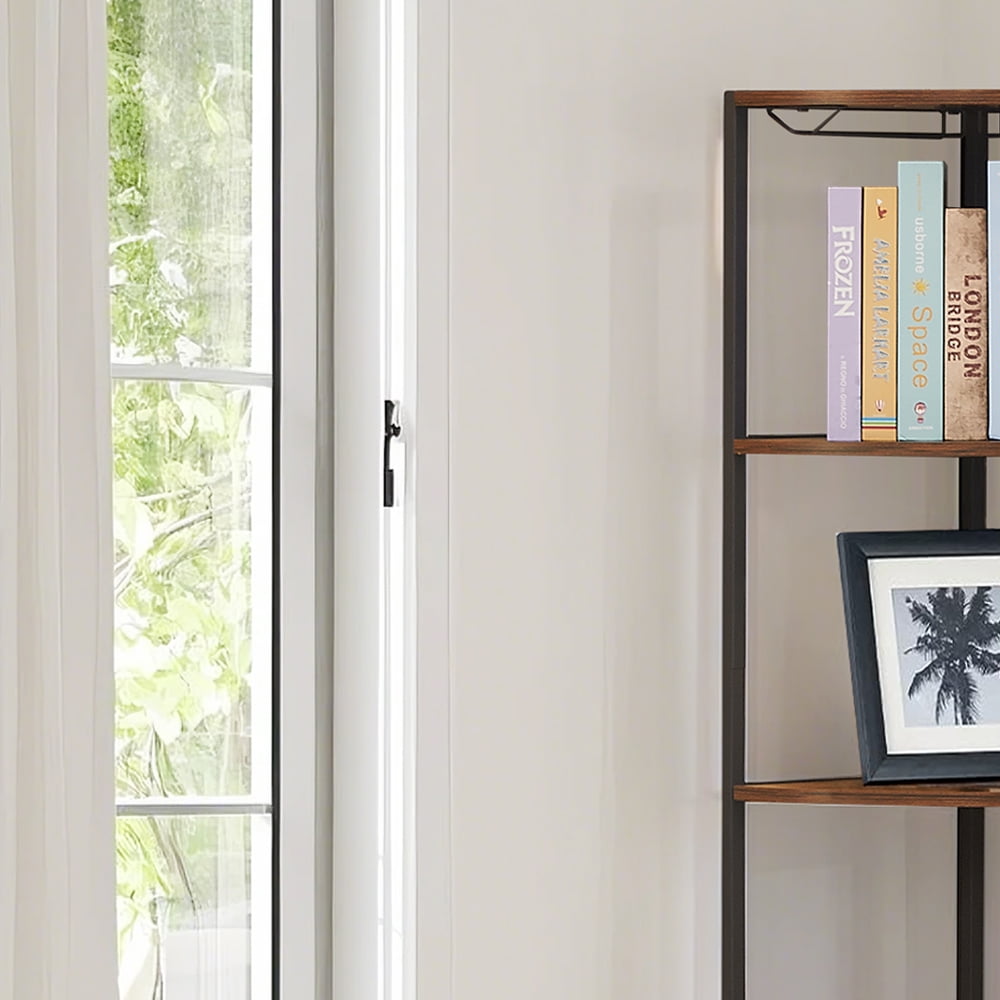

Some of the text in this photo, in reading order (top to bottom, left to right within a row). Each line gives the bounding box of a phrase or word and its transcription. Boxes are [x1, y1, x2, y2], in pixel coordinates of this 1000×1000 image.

[832, 225, 855, 317] FROZEN
[907, 217, 933, 388] usborne Space
[947, 290, 961, 362] BRIDGE
[963, 275, 982, 378] LONDON
